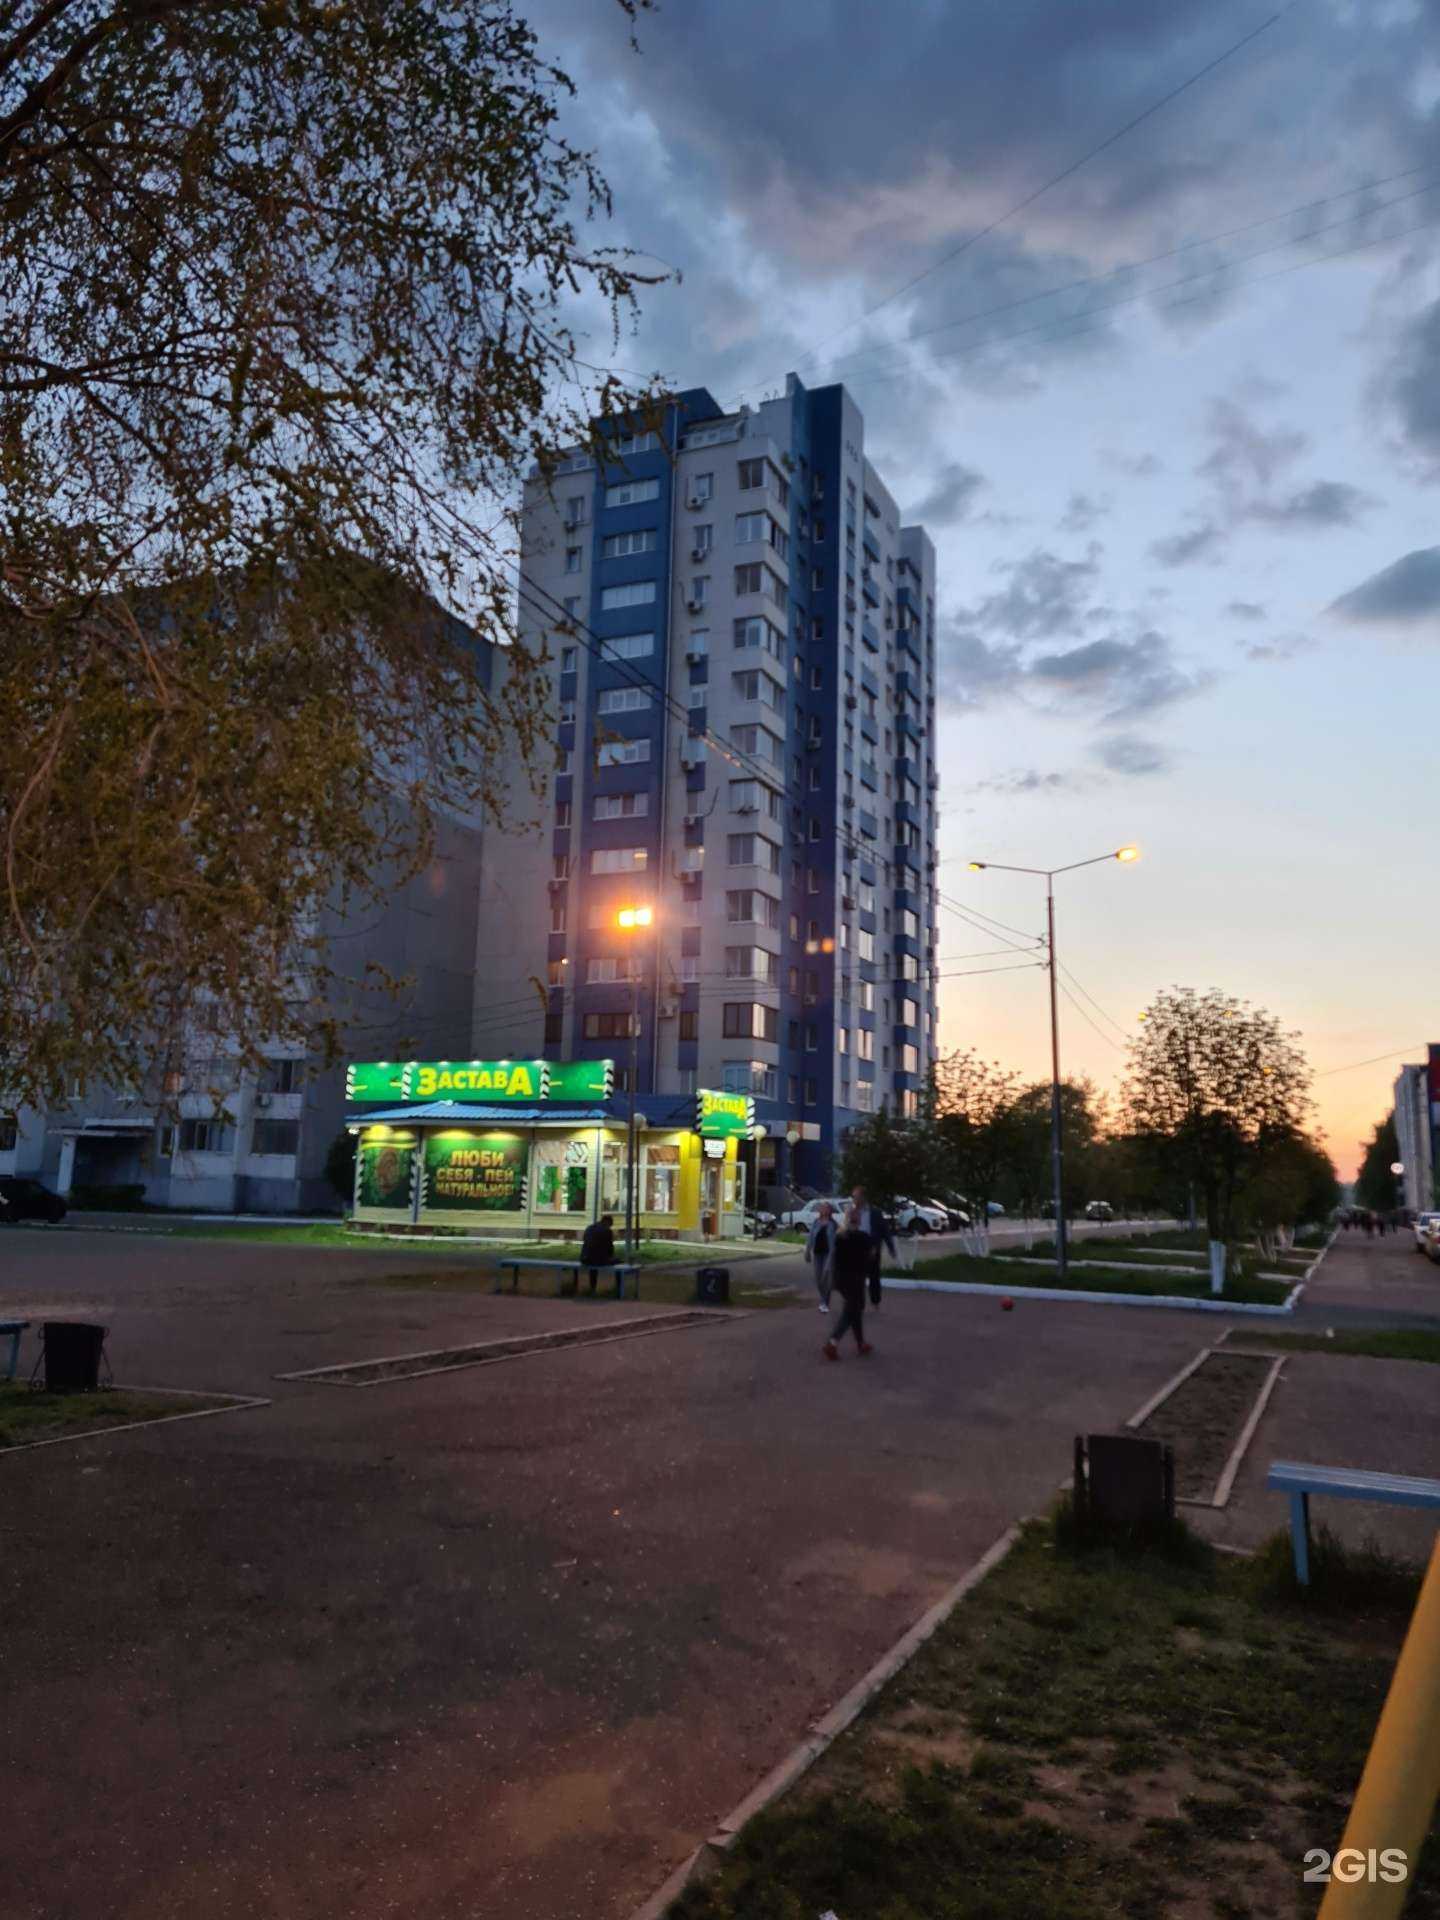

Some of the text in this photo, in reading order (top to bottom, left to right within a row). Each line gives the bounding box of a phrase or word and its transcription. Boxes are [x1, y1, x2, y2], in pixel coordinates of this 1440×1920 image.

[416, 1066, 533, 1095] ЗАСТАВА
[450, 1150, 504, 1167] ЛЮБИ
[436, 1168, 474, 1181] СЕБЯ
[484, 1167, 514, 1182] ПЕЙ
